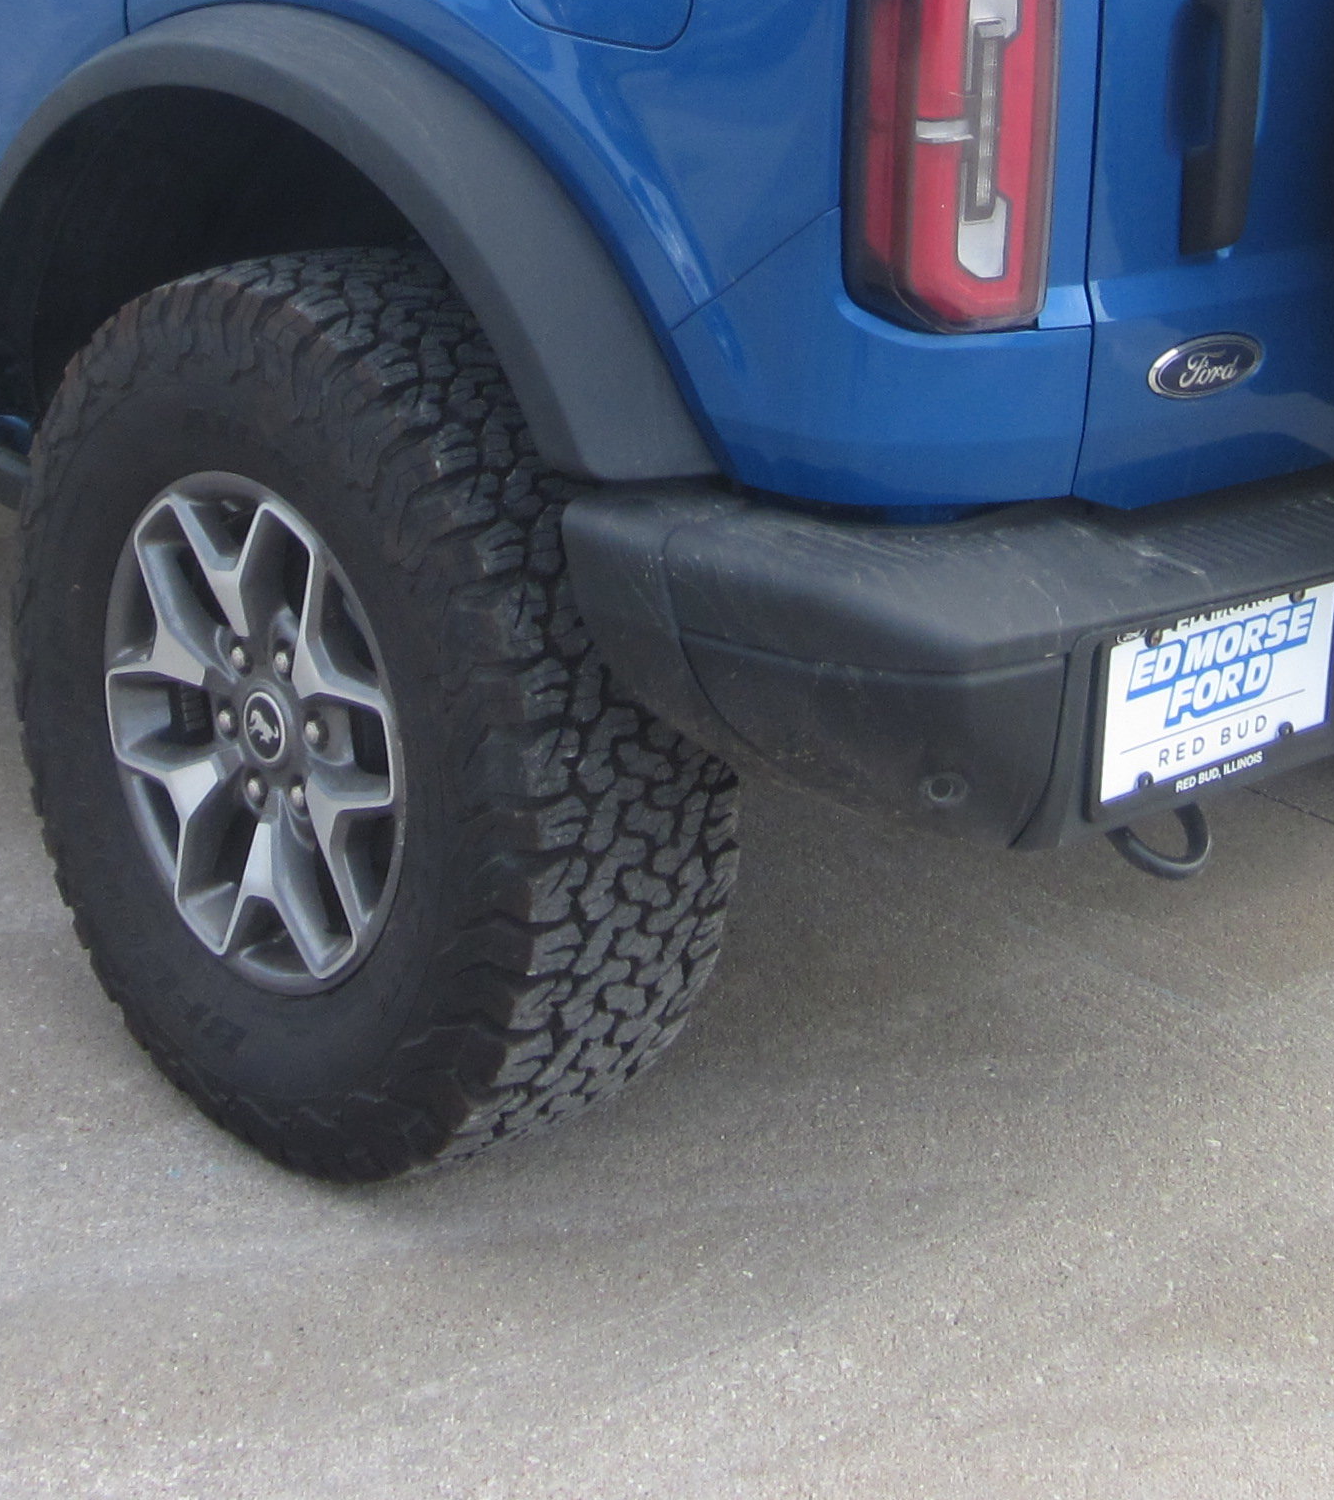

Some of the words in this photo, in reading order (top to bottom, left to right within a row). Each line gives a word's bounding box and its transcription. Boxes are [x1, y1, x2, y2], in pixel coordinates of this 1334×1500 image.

[1178, 349, 1241, 389] Ford
[1126, 639, 1185, 701] ED
[1181, 597, 1317, 677] MORSE
[1164, 653, 1273, 729] FORD
[1158, 736, 1206, 768] RED
[1220, 714, 1268, 746] BUD
[1175, 775, 1197, 793] RED
[1223, 750, 1263, 776] ILLINOIS
